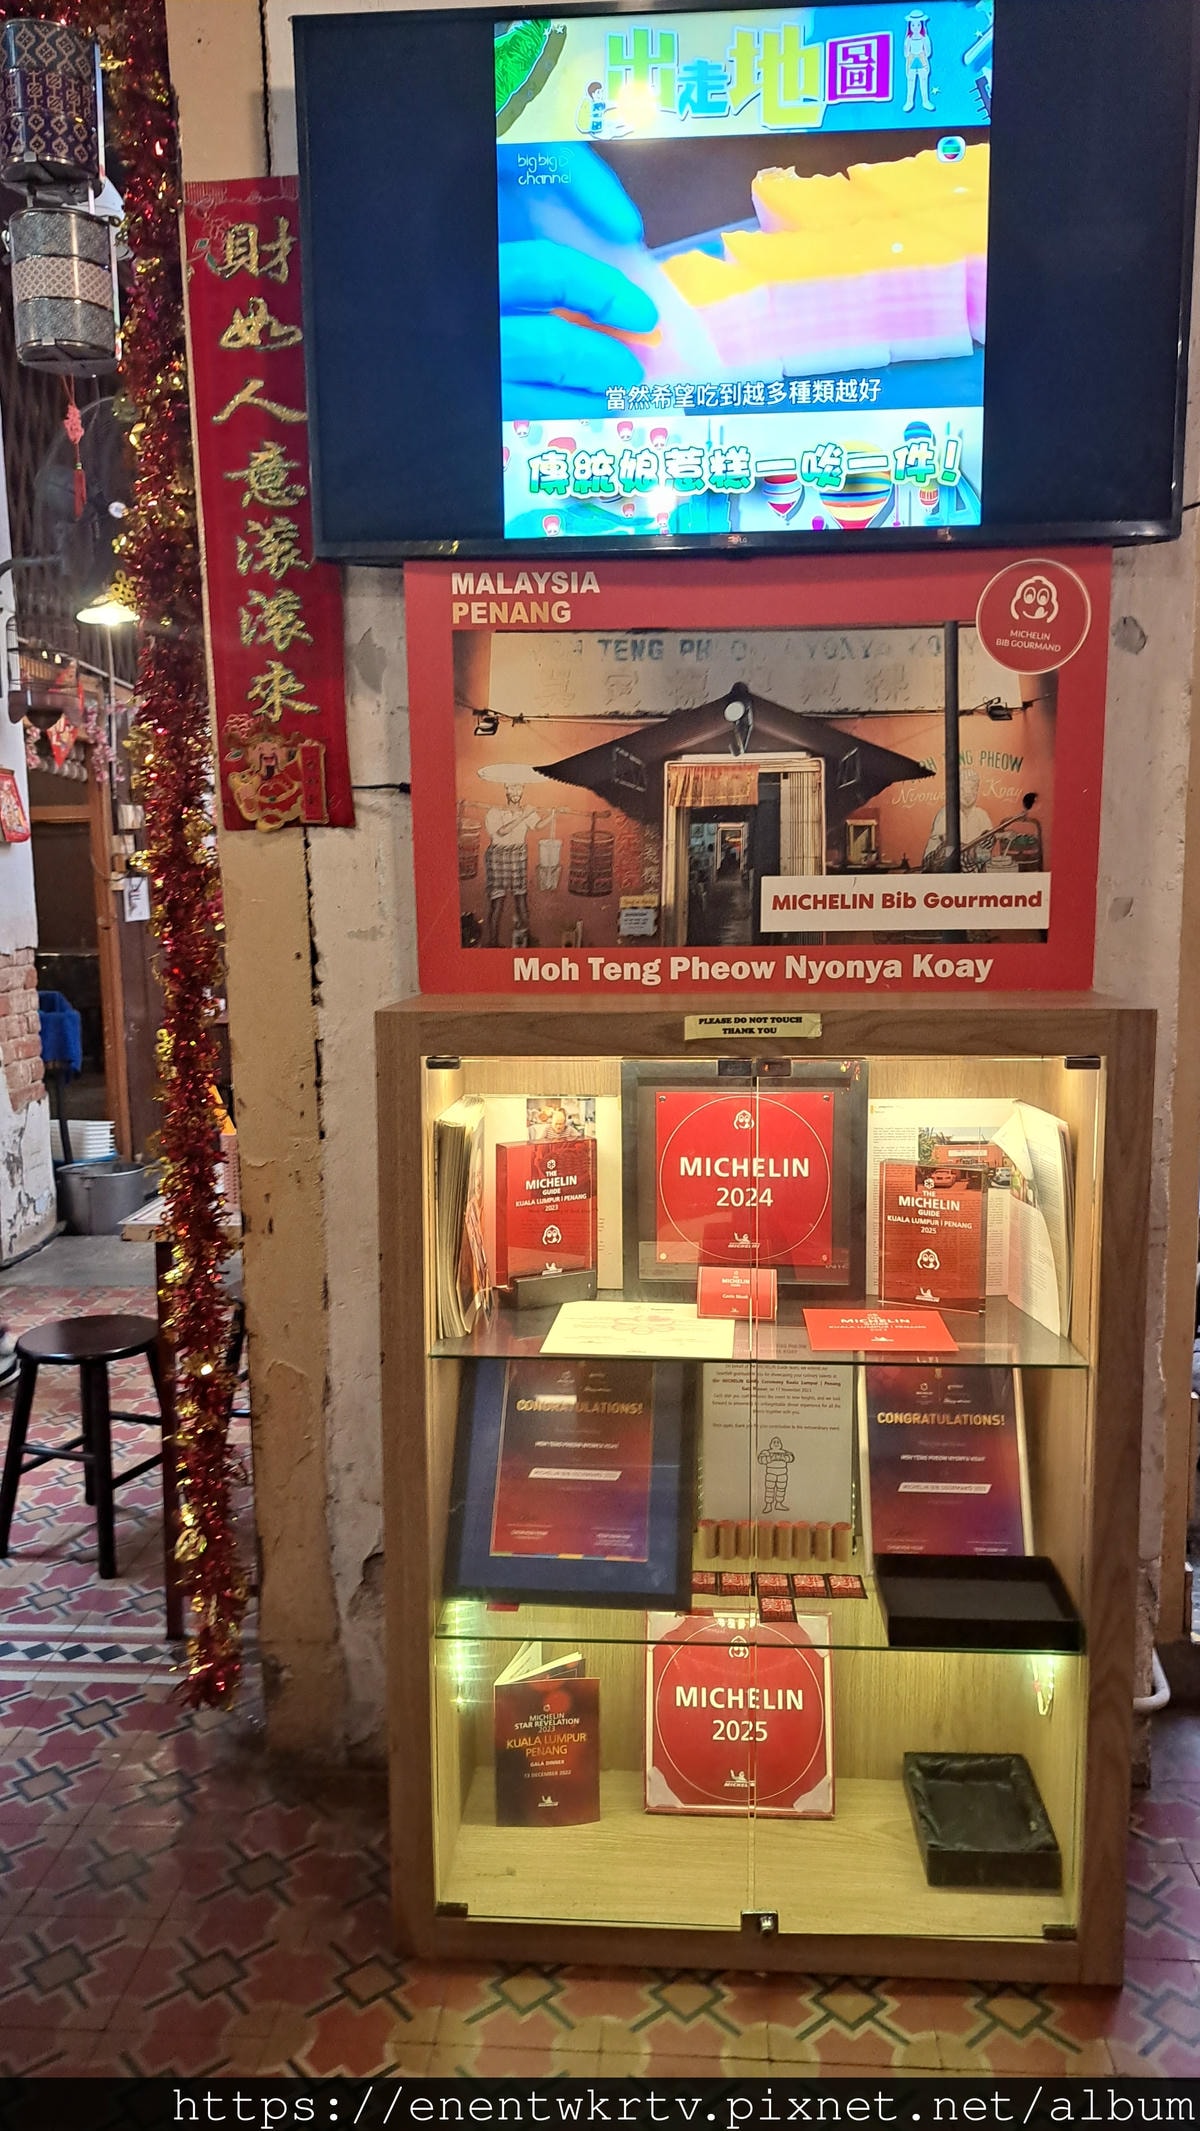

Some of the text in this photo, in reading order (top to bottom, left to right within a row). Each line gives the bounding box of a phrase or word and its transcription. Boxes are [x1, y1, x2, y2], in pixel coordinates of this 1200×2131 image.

[606, 23, 892, 127] 出走地圖
[517, 153, 537, 173] big
[518, 170, 572, 185] channel
[605, 378, 883, 410] 當然希望吃到越多種類越好
[451, 571, 600, 595] MALAYSIA
[452, 601, 571, 624] PENANG
[1009, 630, 1051, 640] MICHELIN
[597, 638, 664, 662] TENG
[996, 638, 1061, 652] BIB GOURMAND
[980, 750, 1024, 773] PHEOW
[772, 890, 1042, 910] MICHELIN Bib Gourmand
[513, 954, 994, 986] Moh Teng Pheow Nyonya Koay
[698, 1016, 803, 1025] PLEASE DO NOT TOUCH
[678, 1156, 809, 1178] MICHELIN
[525, 1175, 577, 1190] MICHELIN
[542, 1188, 561, 1196] GUIDE
[716, 1187, 774, 1207] 2024
[898, 1195, 960, 1211] MICHELIN
[918, 1209, 940, 1217] GUIDE
[887, 1215, 910, 1224] KUALA
[911, 1217, 939, 1226] LUMPUR
[944, 1220, 972, 1229] PENANG
[876, 1411, 1006, 1426] CONGRATULATIONS!
[675, 1685, 803, 1710] MICHELIN
[514, 1718, 580, 1730] STAR REVELATION
[529, 1713, 564, 1722] MICHELIN
[712, 1720, 768, 1741] 2025
[506, 1732, 587, 1749] KUALA LUMPUR
[525, 1745, 568, 1758] PENANG
